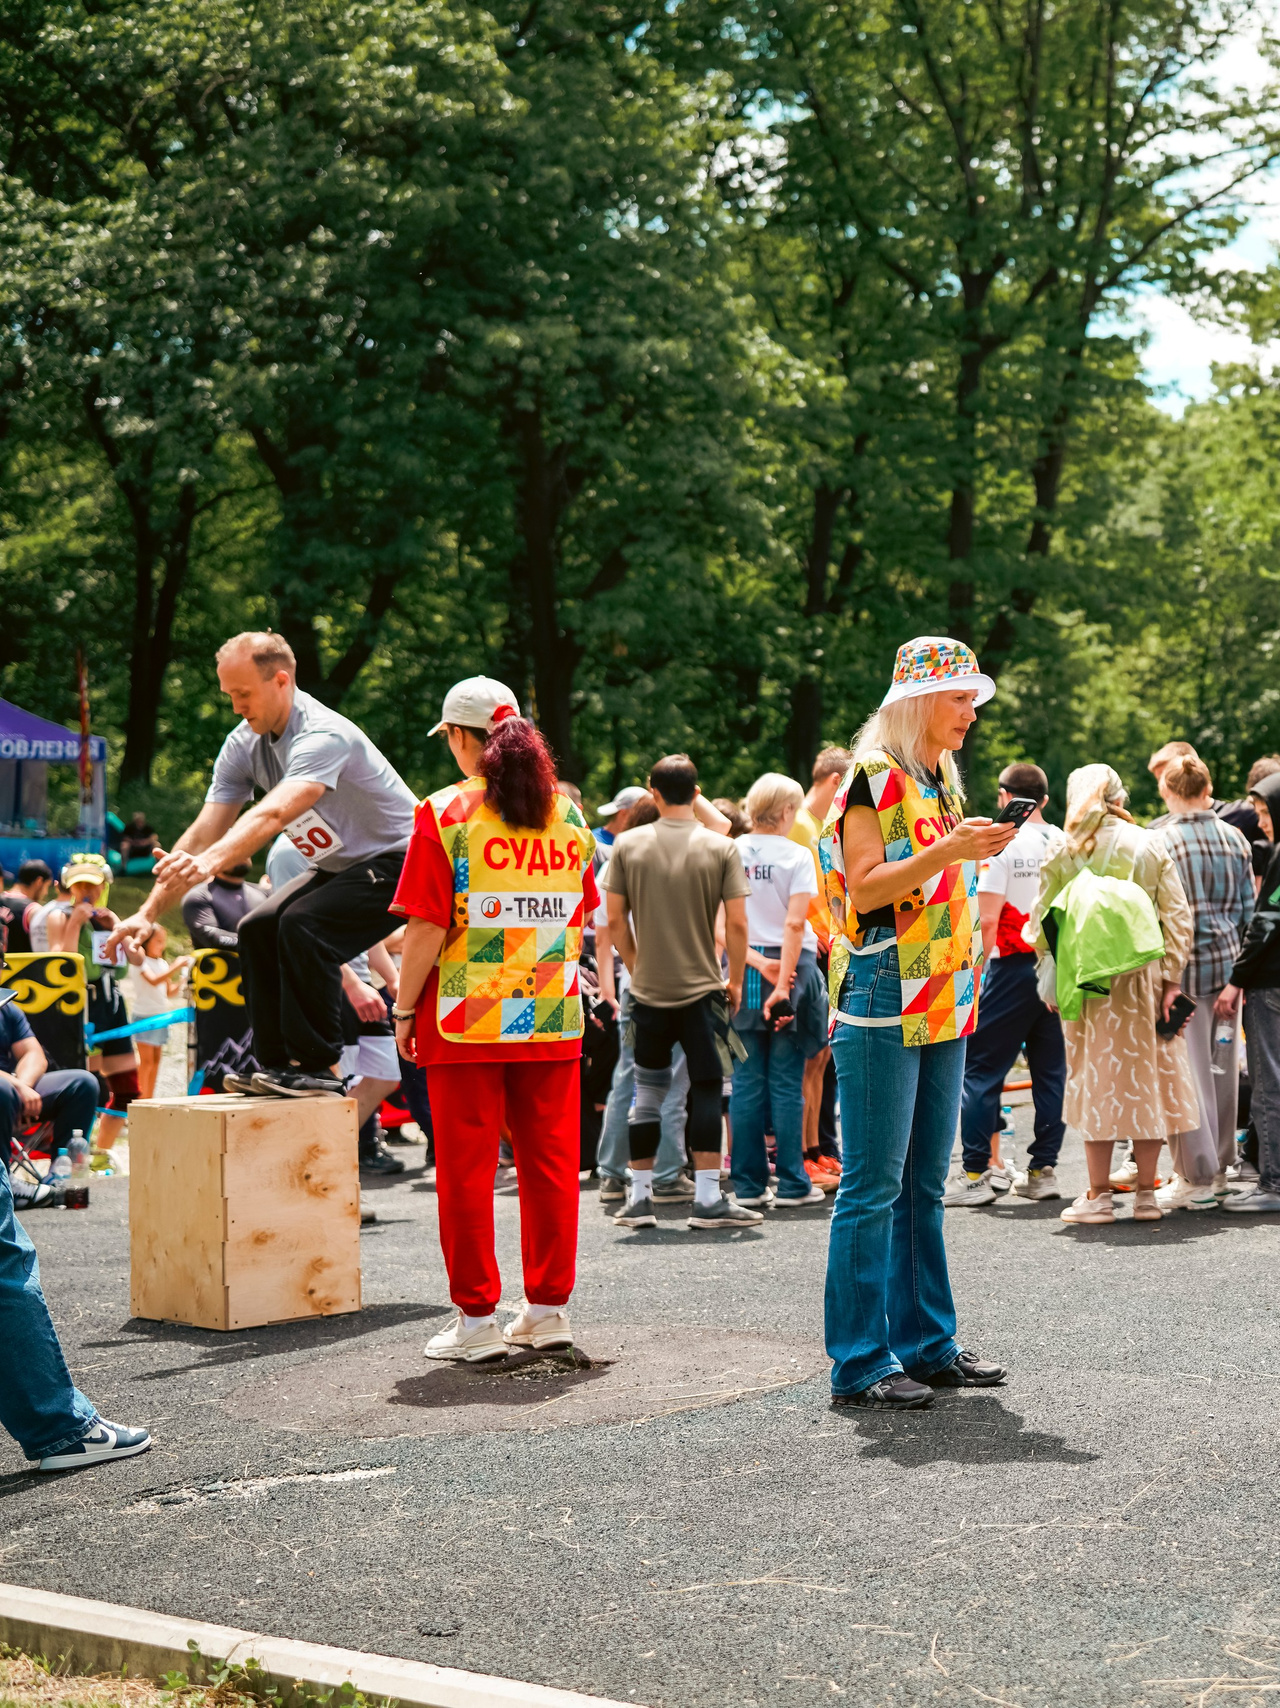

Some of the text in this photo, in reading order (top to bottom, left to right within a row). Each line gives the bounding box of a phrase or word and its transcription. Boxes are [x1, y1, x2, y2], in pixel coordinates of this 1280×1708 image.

[291, 826, 333, 857] 50
[483, 837, 580, 876] СУДЬЯ
[755, 864, 774, 880] БЕГ
[966, 1180, 985, 1190] HOKA
